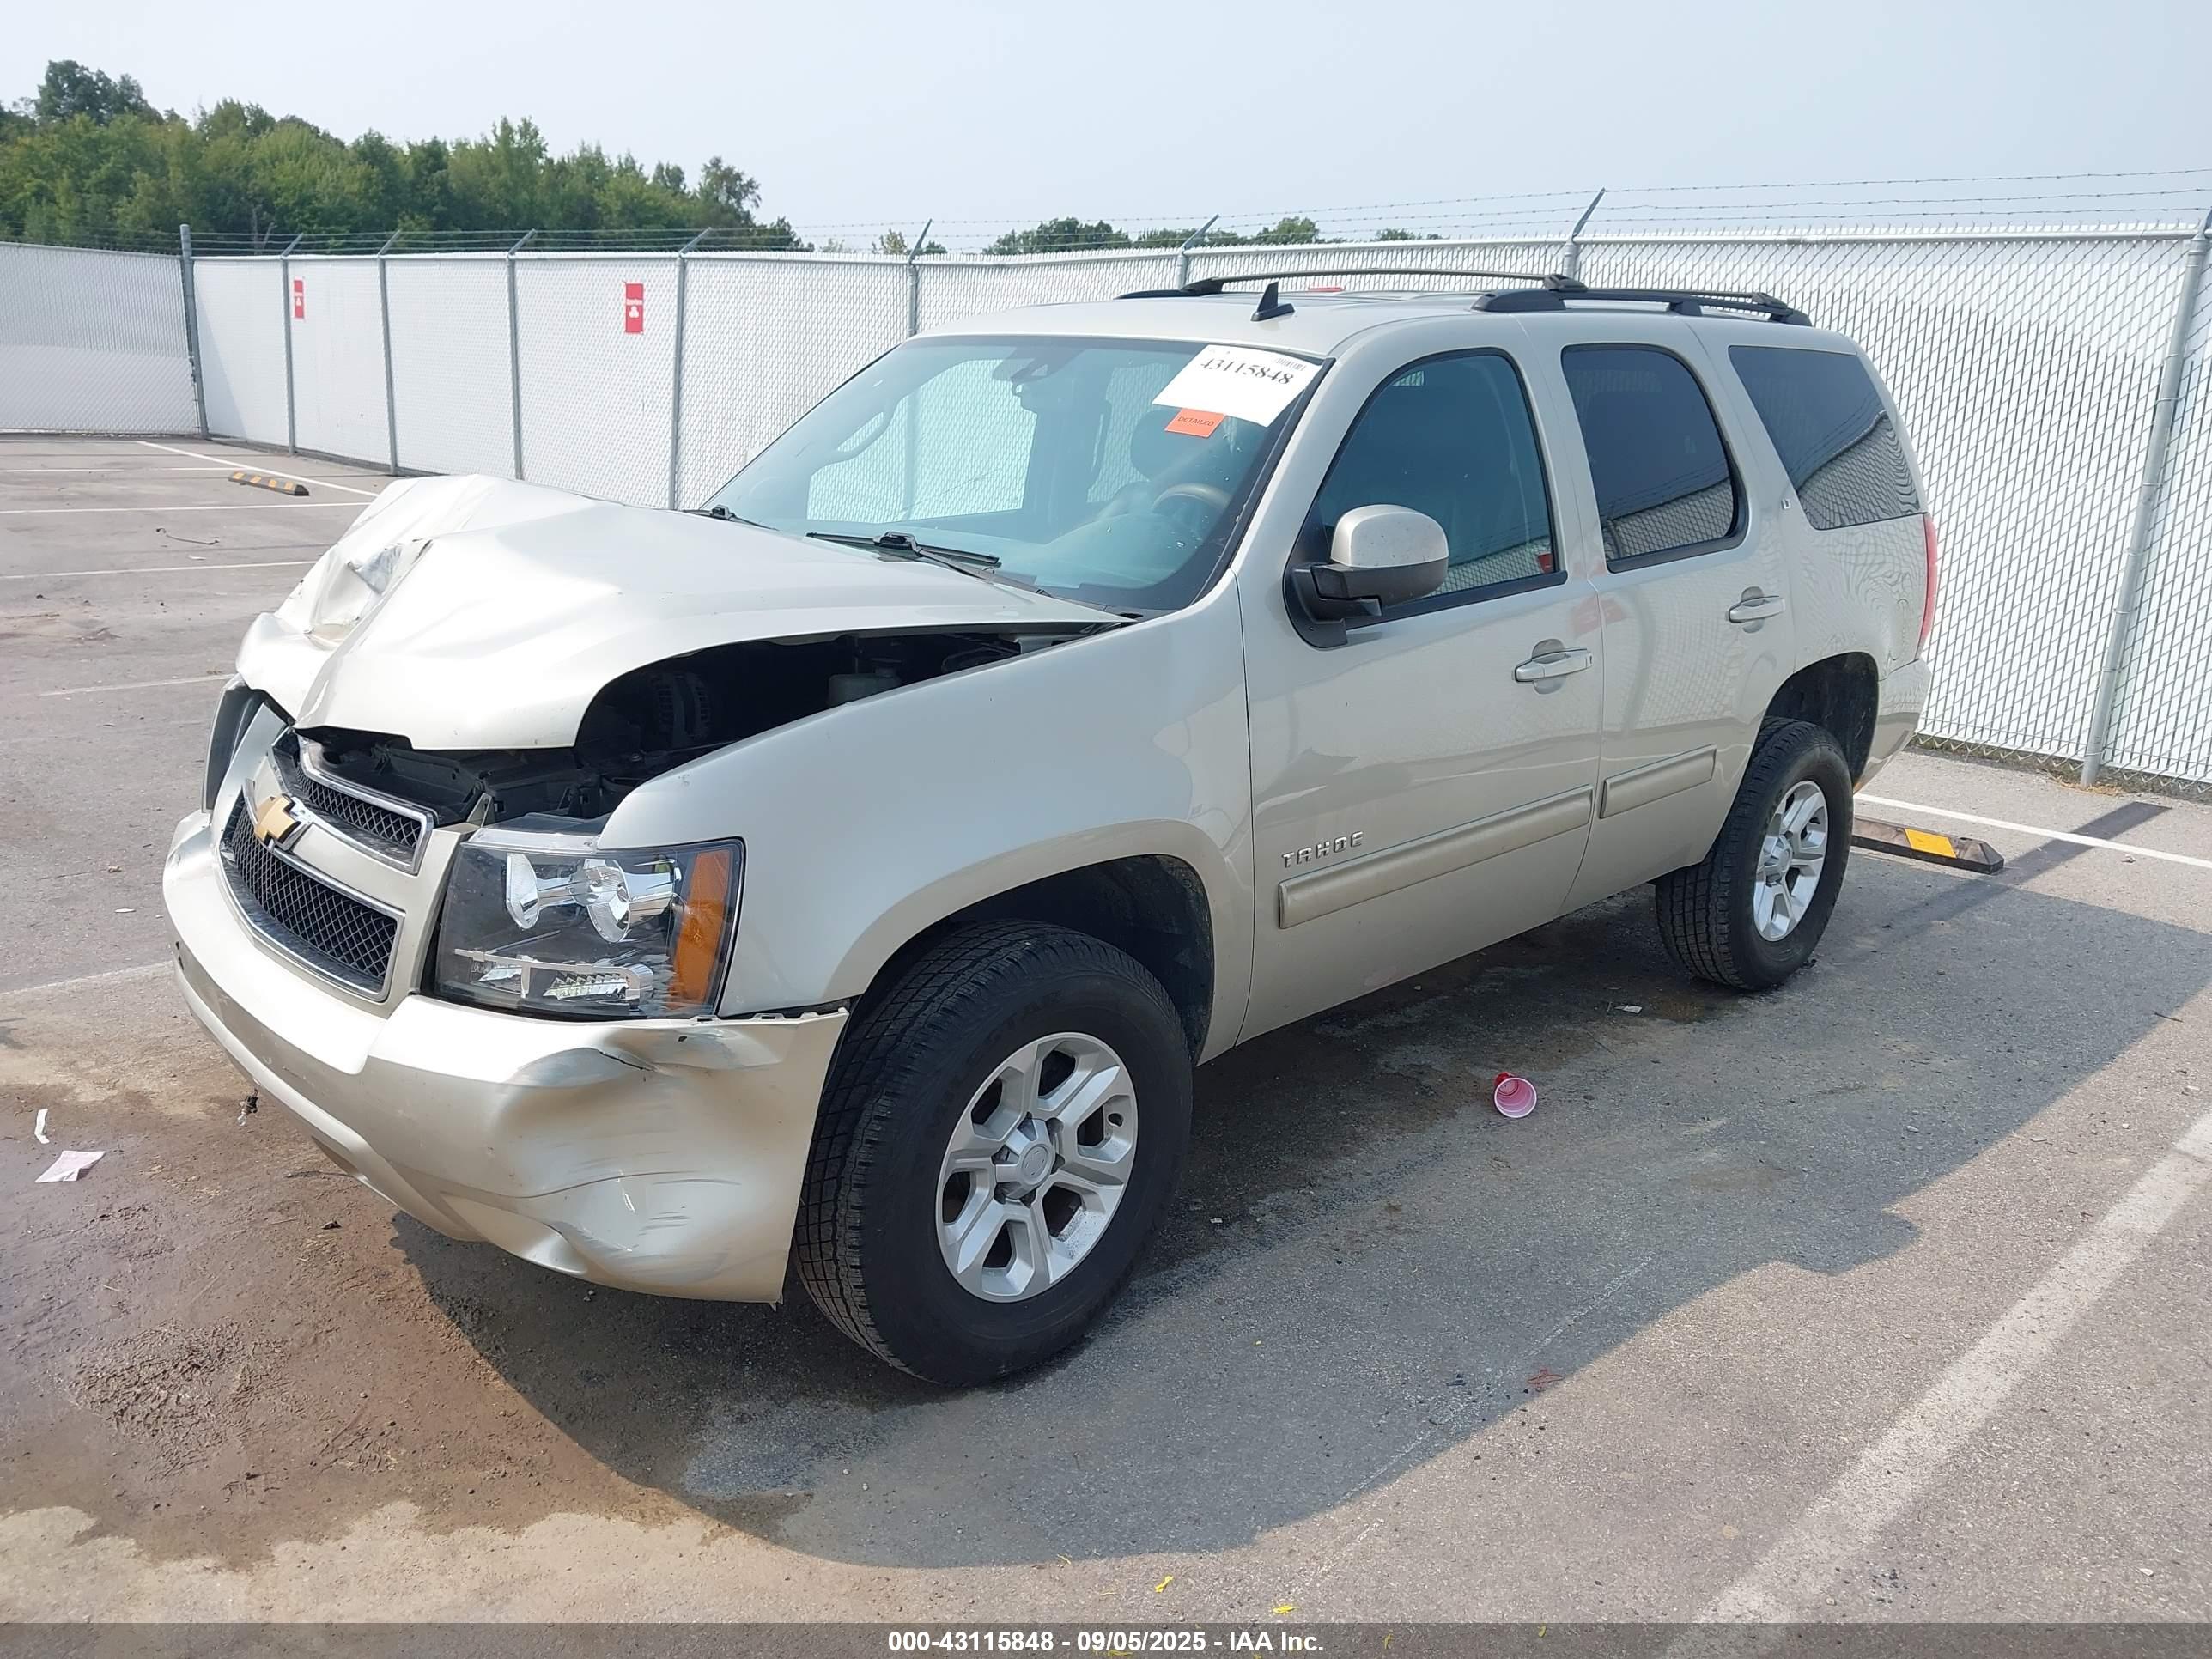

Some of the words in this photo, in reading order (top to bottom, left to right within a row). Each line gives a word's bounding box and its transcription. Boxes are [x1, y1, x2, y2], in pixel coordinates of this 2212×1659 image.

[1200, 357, 1294, 385] 43115848
[1177, 416, 1214, 427] DETAILED
[1281, 831, 1364, 868] TAHOE
